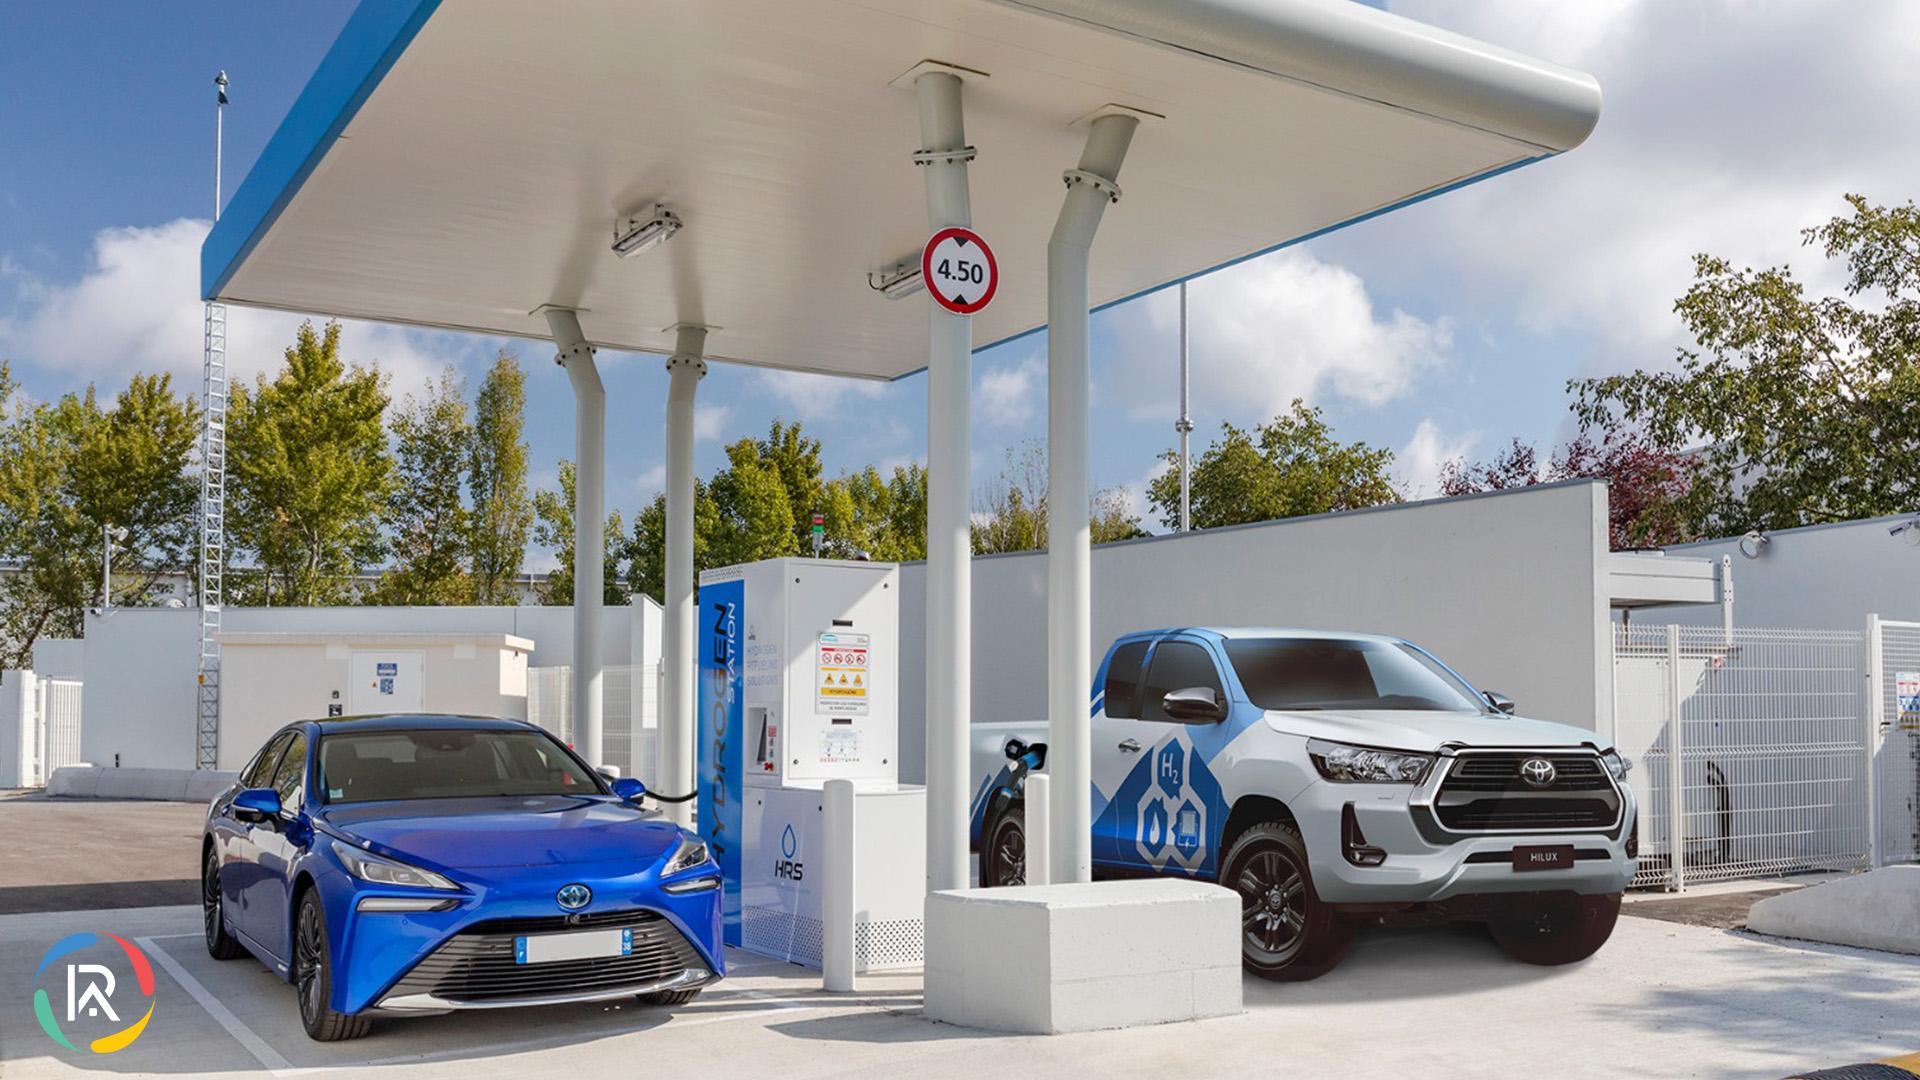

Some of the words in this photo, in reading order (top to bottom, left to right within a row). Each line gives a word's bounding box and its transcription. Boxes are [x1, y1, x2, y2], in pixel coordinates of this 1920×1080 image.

[937, 258, 983, 285] 4.50
[727, 602, 736, 704] STATION
[1530, 852, 1558, 862] HILUX
[775, 859, 803, 881] HRS
